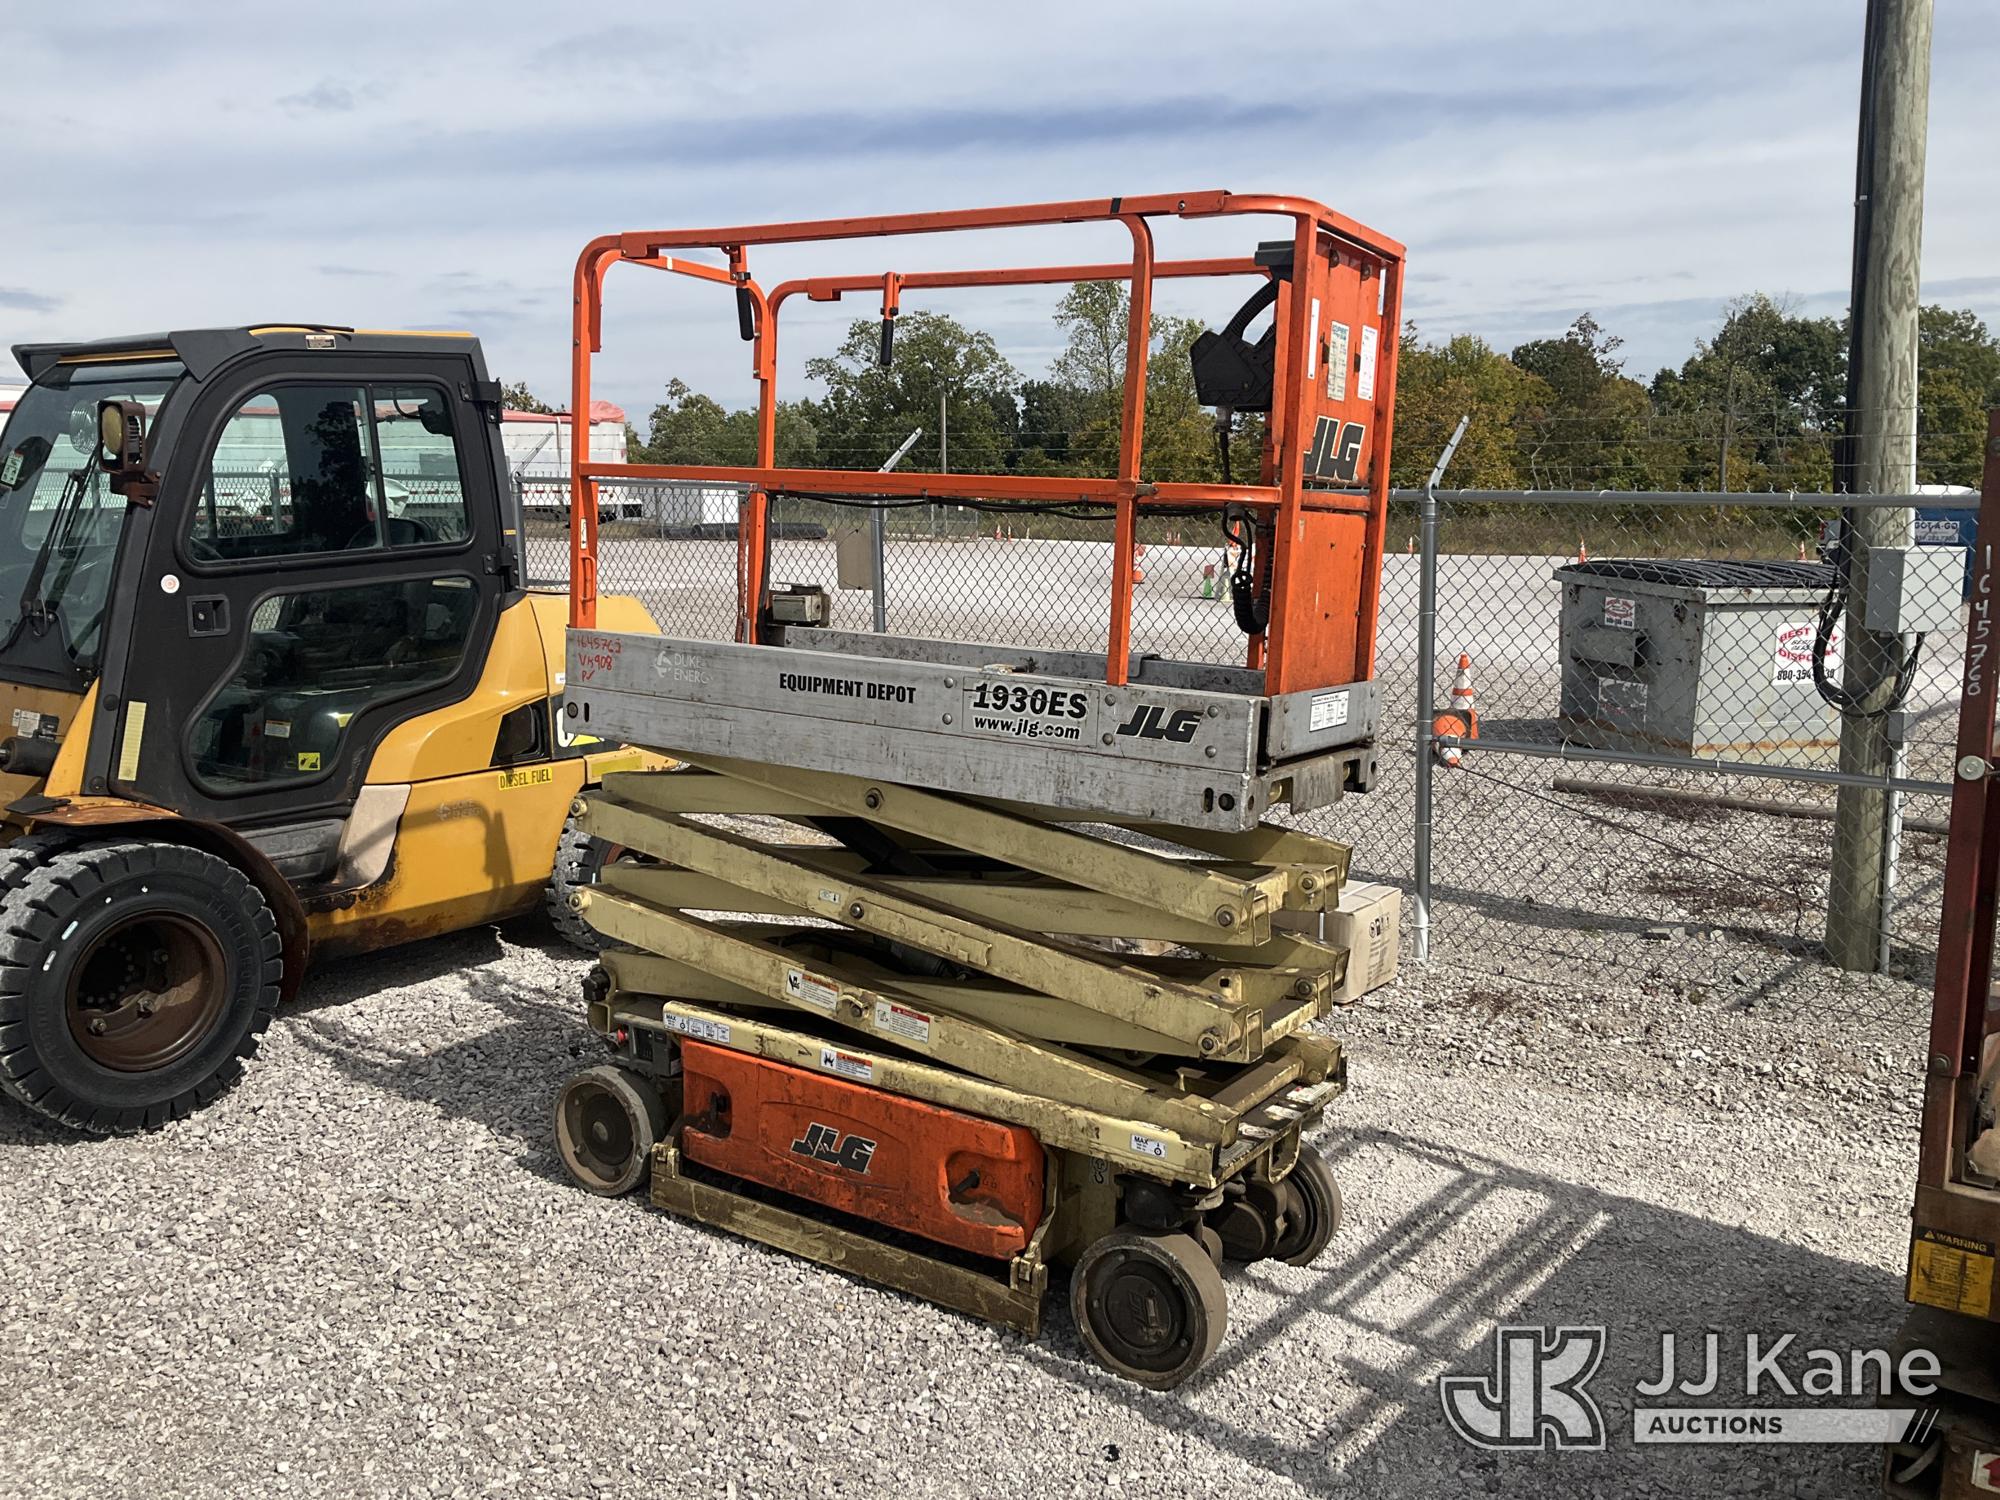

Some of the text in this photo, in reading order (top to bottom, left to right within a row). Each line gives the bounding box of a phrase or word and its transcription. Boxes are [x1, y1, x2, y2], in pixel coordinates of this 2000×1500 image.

[1303, 415, 1366, 482] JLG
[1967, 544, 1992, 696] 1645760
[674, 653, 705, 669] DUKE
[674, 668, 713, 684] ENERG
[780, 673, 916, 704] EQUIPMENT DEPOT
[973, 683, 1088, 719] 1930ES
[974, 717, 1080, 740] www.jlg.com
[1115, 704, 1204, 744] JLG
[532, 768, 551, 783] FUEL
[790, 1122, 877, 1175] JLG
[1936, 1232, 1987, 1252] WARNING
